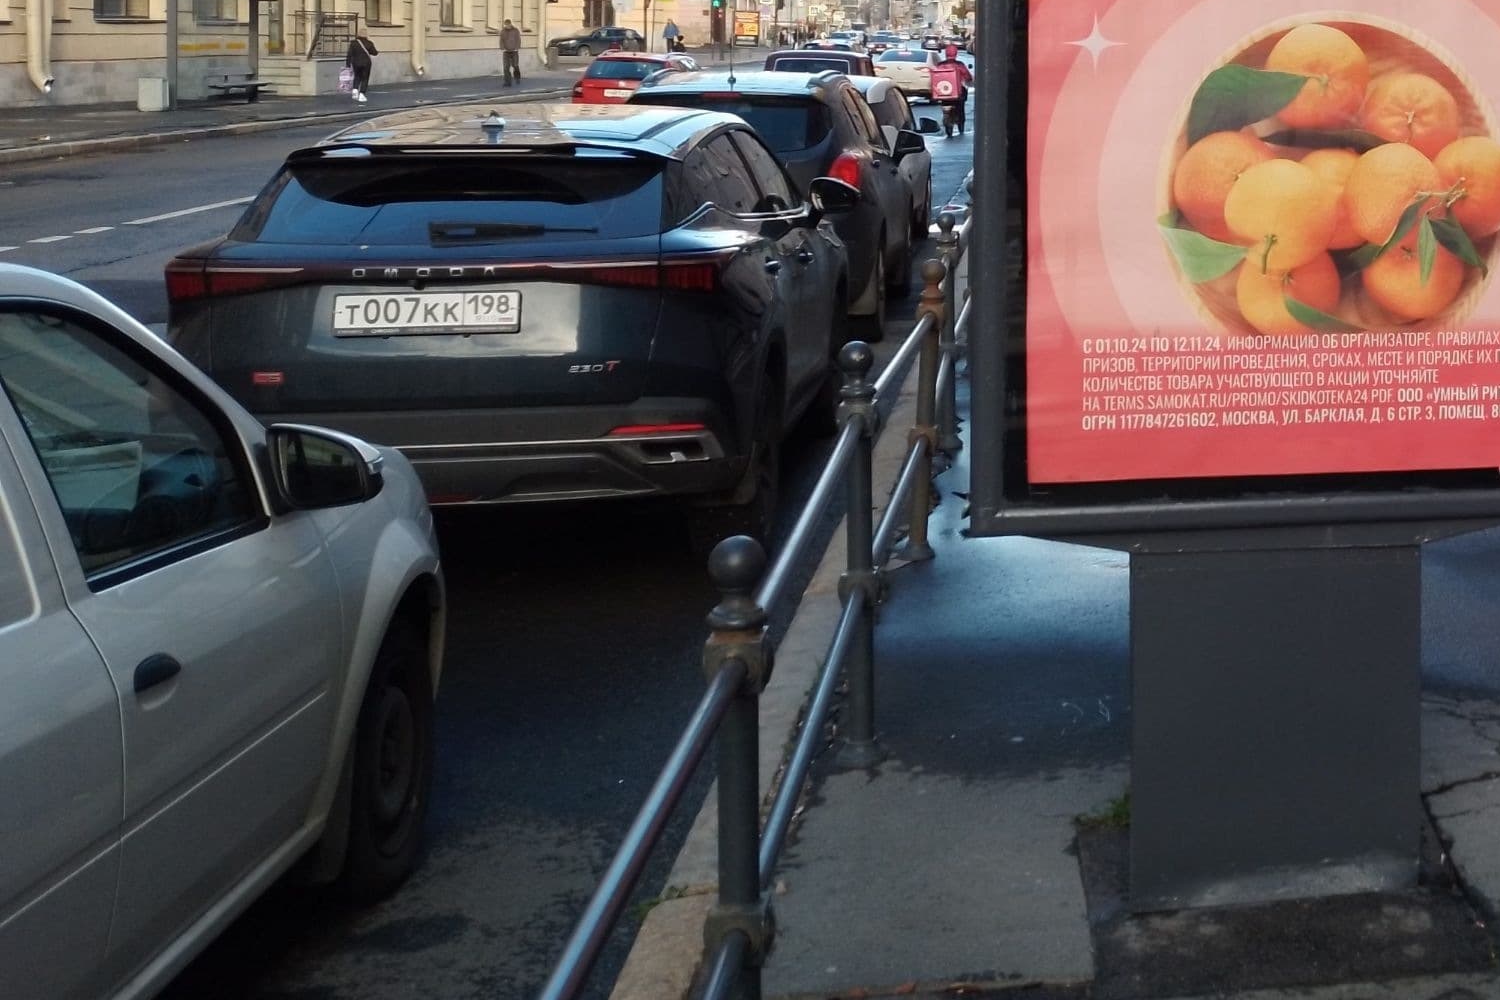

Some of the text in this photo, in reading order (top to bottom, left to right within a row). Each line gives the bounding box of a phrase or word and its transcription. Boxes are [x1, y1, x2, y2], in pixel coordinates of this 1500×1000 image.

[467, 294, 510, 315] 198
[1095, 337, 1147, 354] 01.10.24
[1150, 336, 1169, 352] ПО
[1227, 333, 1319, 351] ИНФОРМАЦИЮ
[1322, 333, 1338, 348] ОБ
[1341, 331, 1435, 348] ОРГАНИЗАТОРЕ,
[1141, 355, 1220, 372] ТЕРРИТОРИИ
[1223, 353, 1310, 370] ПРОВЕДЕНИЯ,
[1312, 352, 1365, 368] СРОКАХ,
[1367, 350, 1403, 366] МЕСТЕ
[1406, 350, 1414, 365] И
[1417, 349, 1473, 366] ПОРЯДКЕ
[1476, 349, 1492, 363] ИХ
[1083, 366, 1439, 392] КОЛИЧЕСТВЕ ТОВАРА УЧАСТВУЮЩЕГО В АКЦИИ УТОЧНЯЙТЕ
[1082, 396, 1100, 411] НА
[1397, 387, 1423, 402] ООО
[1426, 384, 1479, 403] «УМНЫЙ
[1082, 414, 1116, 430] ОГРН
[1119, 412, 1219, 430] 1177847261602,
[1222, 409, 1279, 426] МОСКВА,
[1281, 409, 1302, 426] УЛ.
[1305, 407, 1367, 423] БАРКЛАЯ,
[1387, 406, 1395, 420] 6
[1398, 405, 1422, 420] СТР.
[1439, 404, 1488, 420] ПОМЕЩ.
